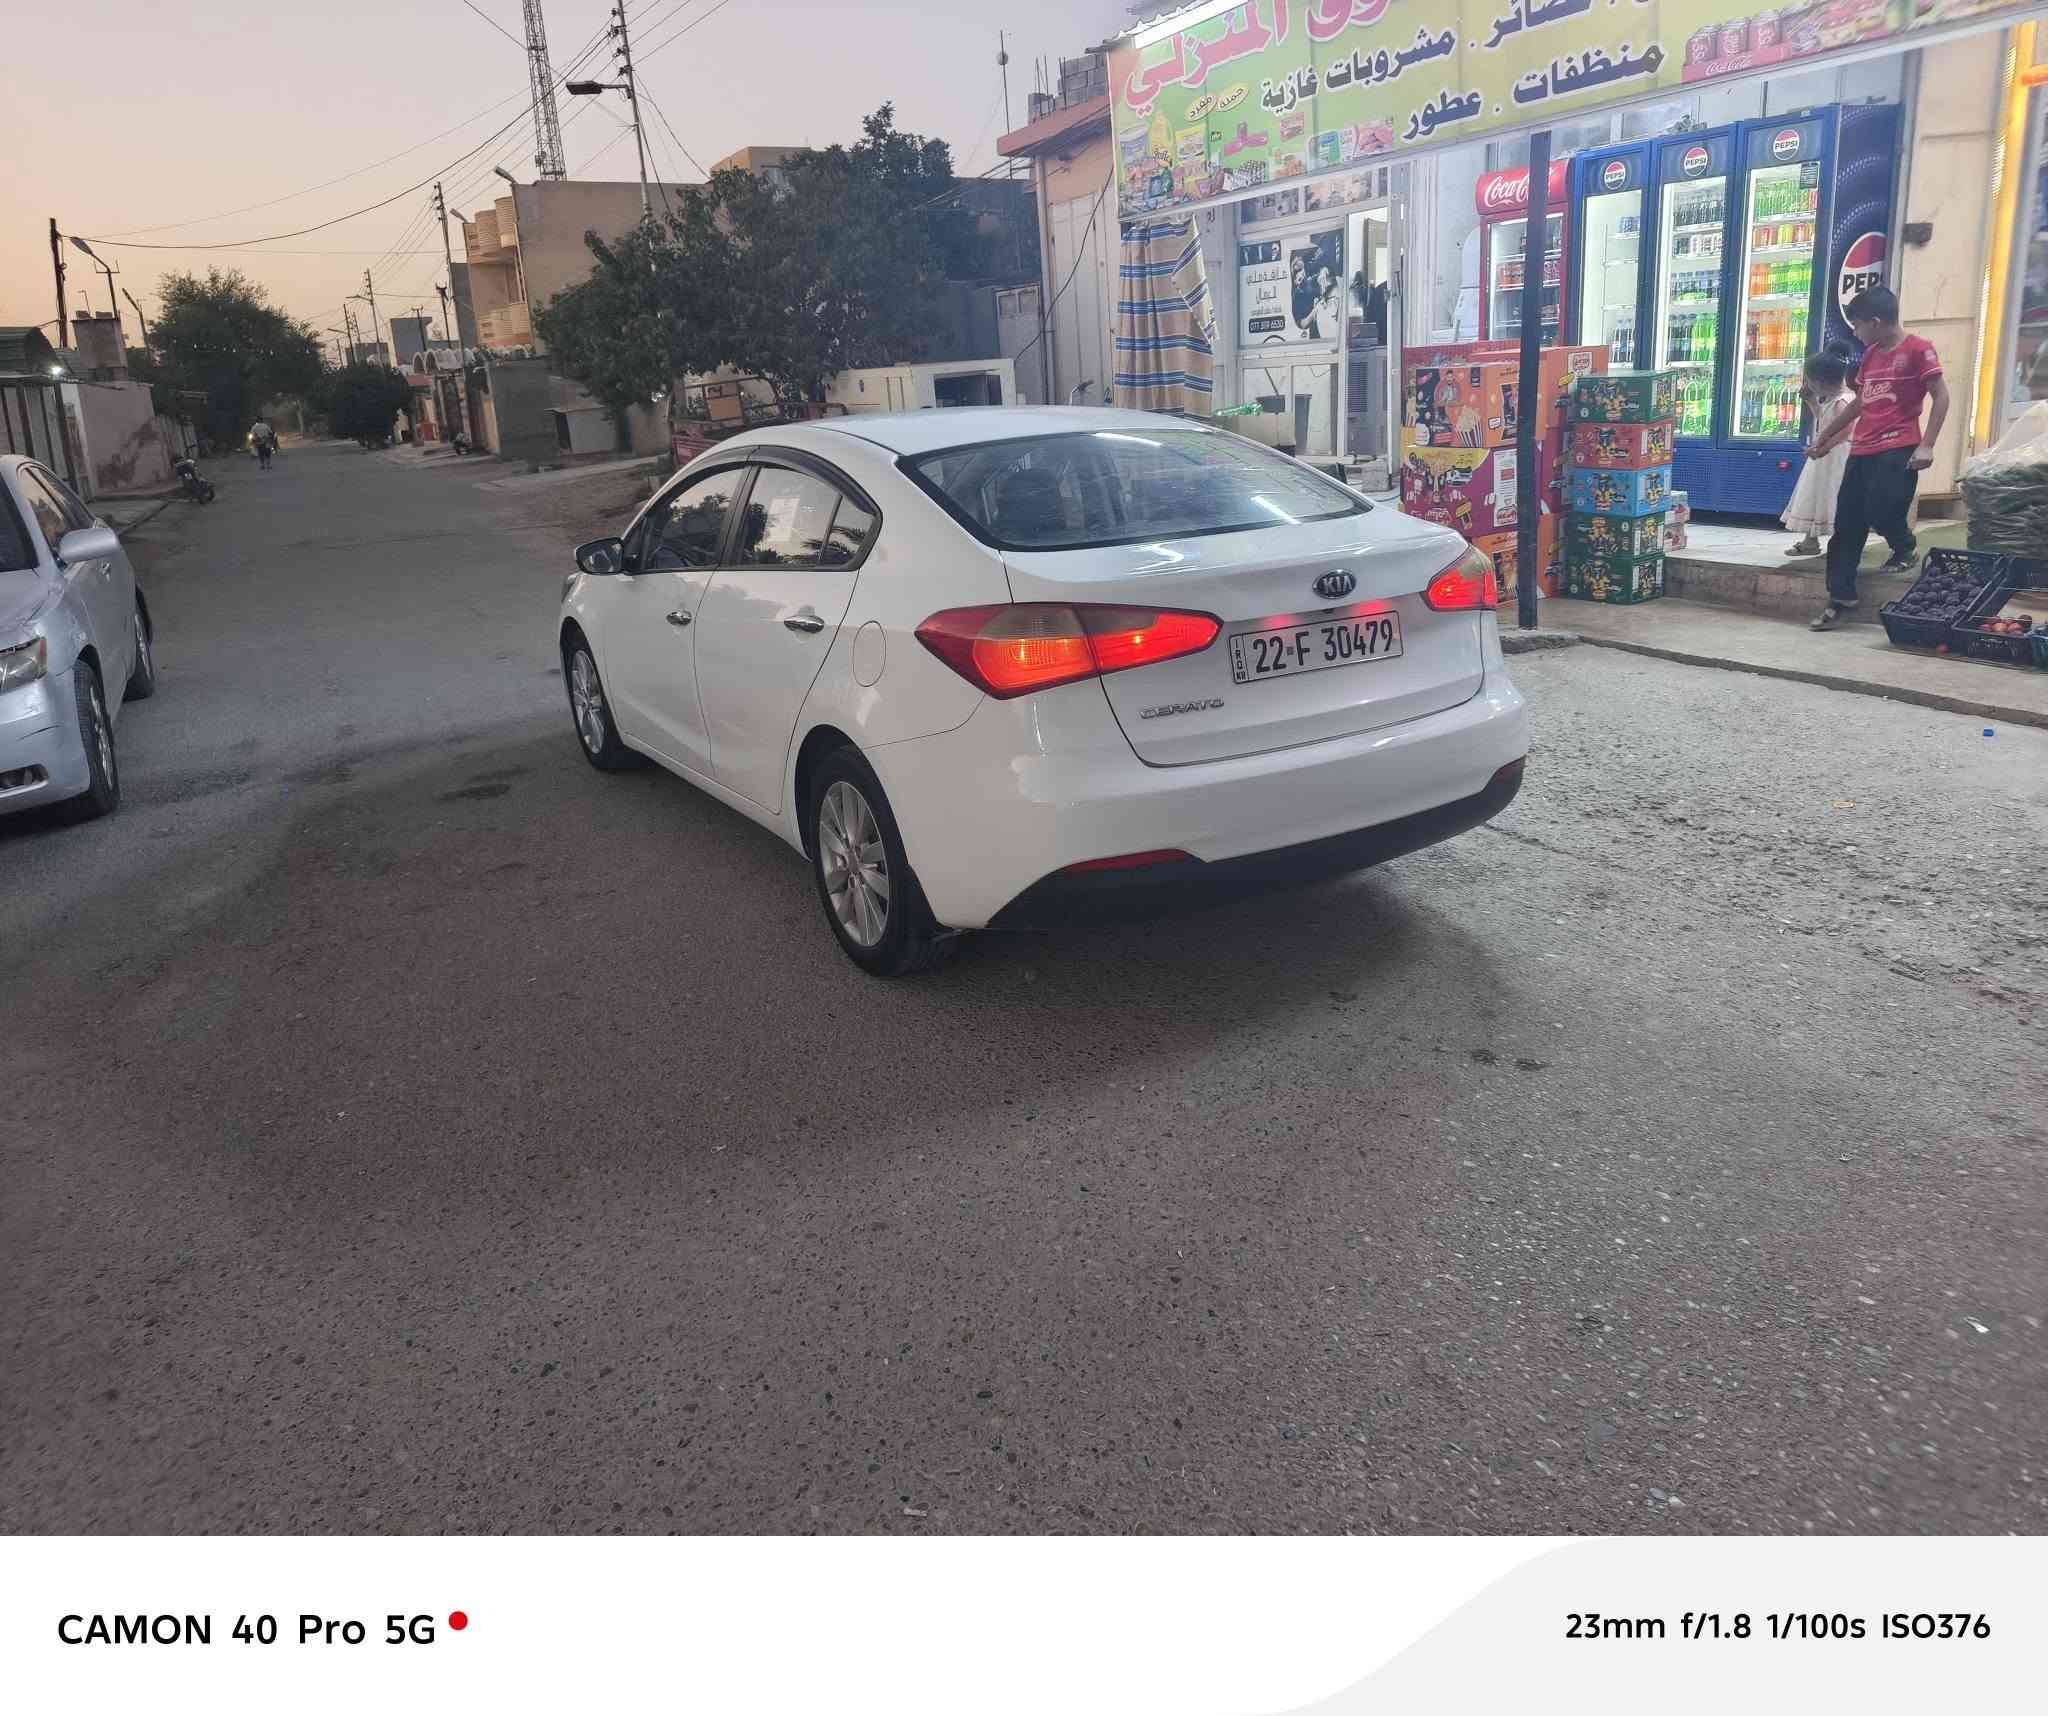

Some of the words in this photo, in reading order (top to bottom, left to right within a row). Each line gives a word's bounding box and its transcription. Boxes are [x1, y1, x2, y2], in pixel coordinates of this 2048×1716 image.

[1326, 28, 1456, 88] مشروبات
[1514, 44, 1665, 104] منظفات
[1262, 67, 1319, 113] غازية
[1402, 90, 1482, 140] عطور
[1684, 157, 1708, 167] PEPSI
[1774, 139, 1799, 150] PEPSI
[1842, 271, 1884, 295] PEP
[1322, 575, 1353, 594] KIA
[1321, 618, 1393, 661] 30479
